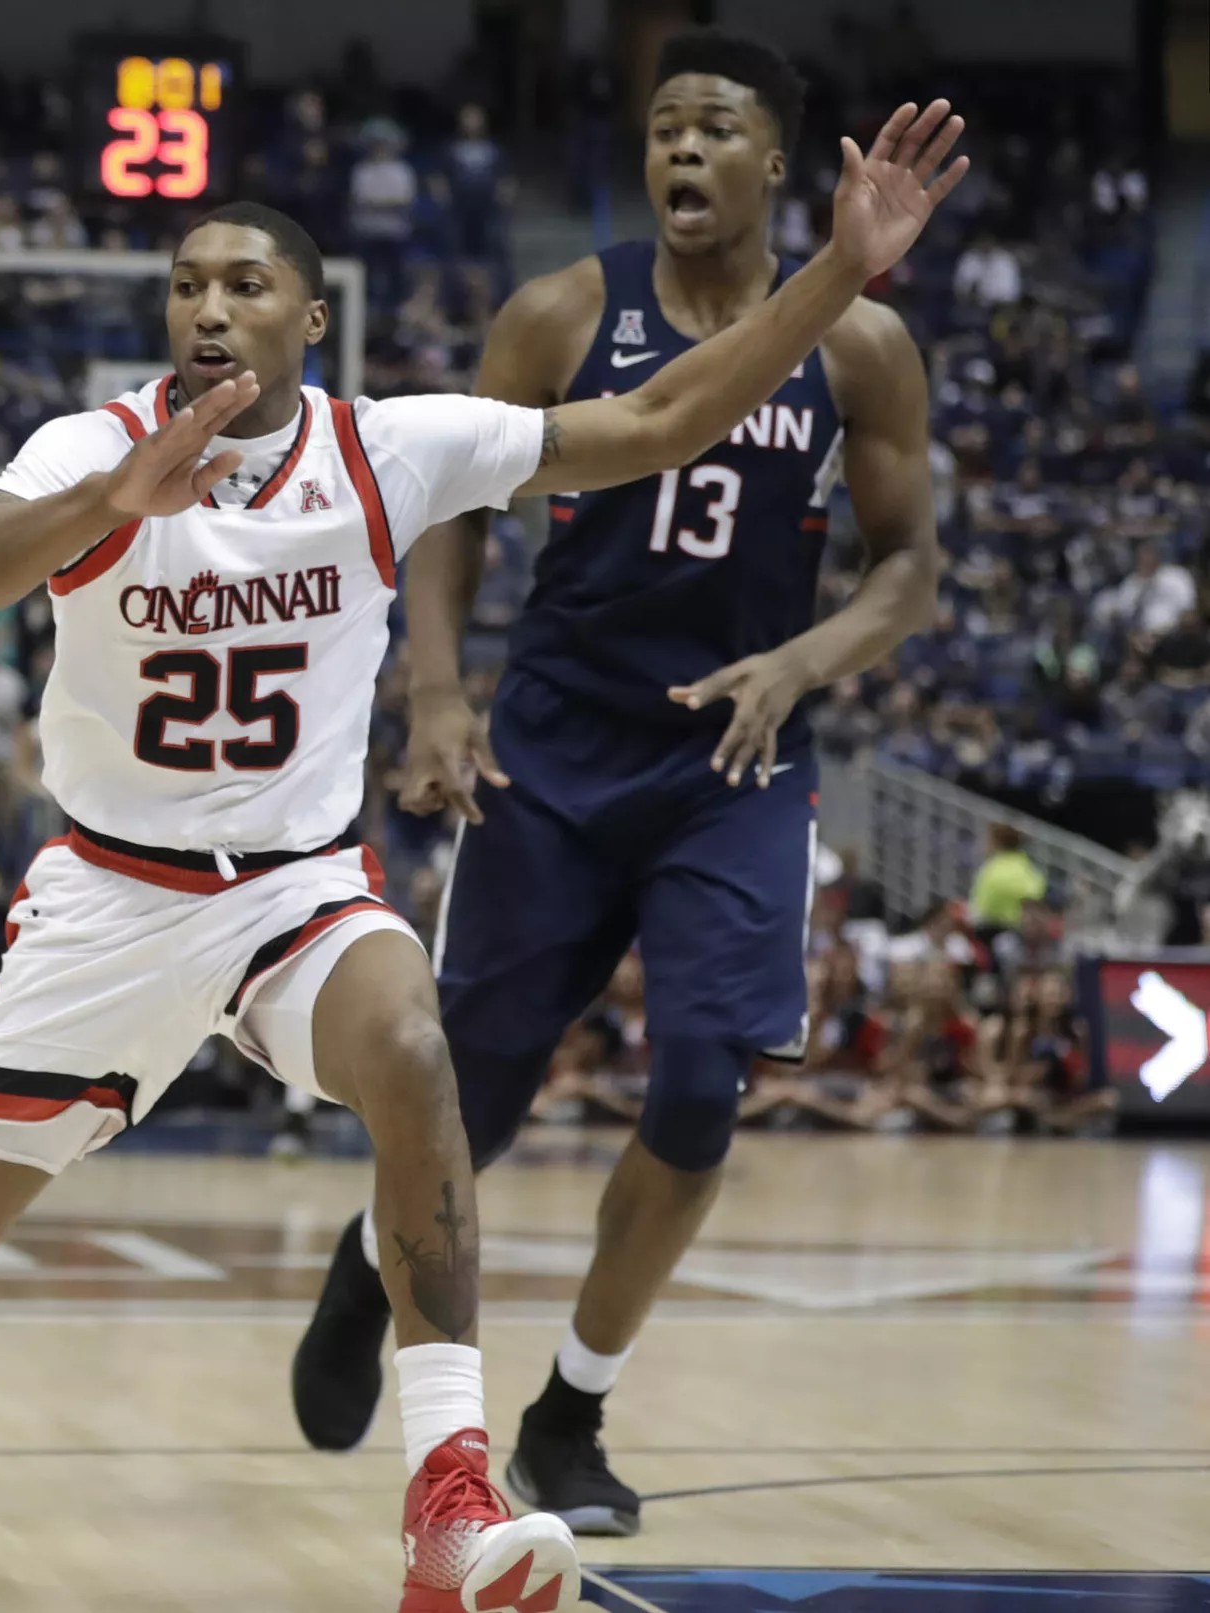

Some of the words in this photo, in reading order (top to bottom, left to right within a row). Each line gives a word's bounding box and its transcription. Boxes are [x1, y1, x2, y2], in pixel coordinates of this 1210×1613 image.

[101, 107, 208, 198] 23
[649, 464, 742, 559] 13
[134, 642, 309, 771] 25
